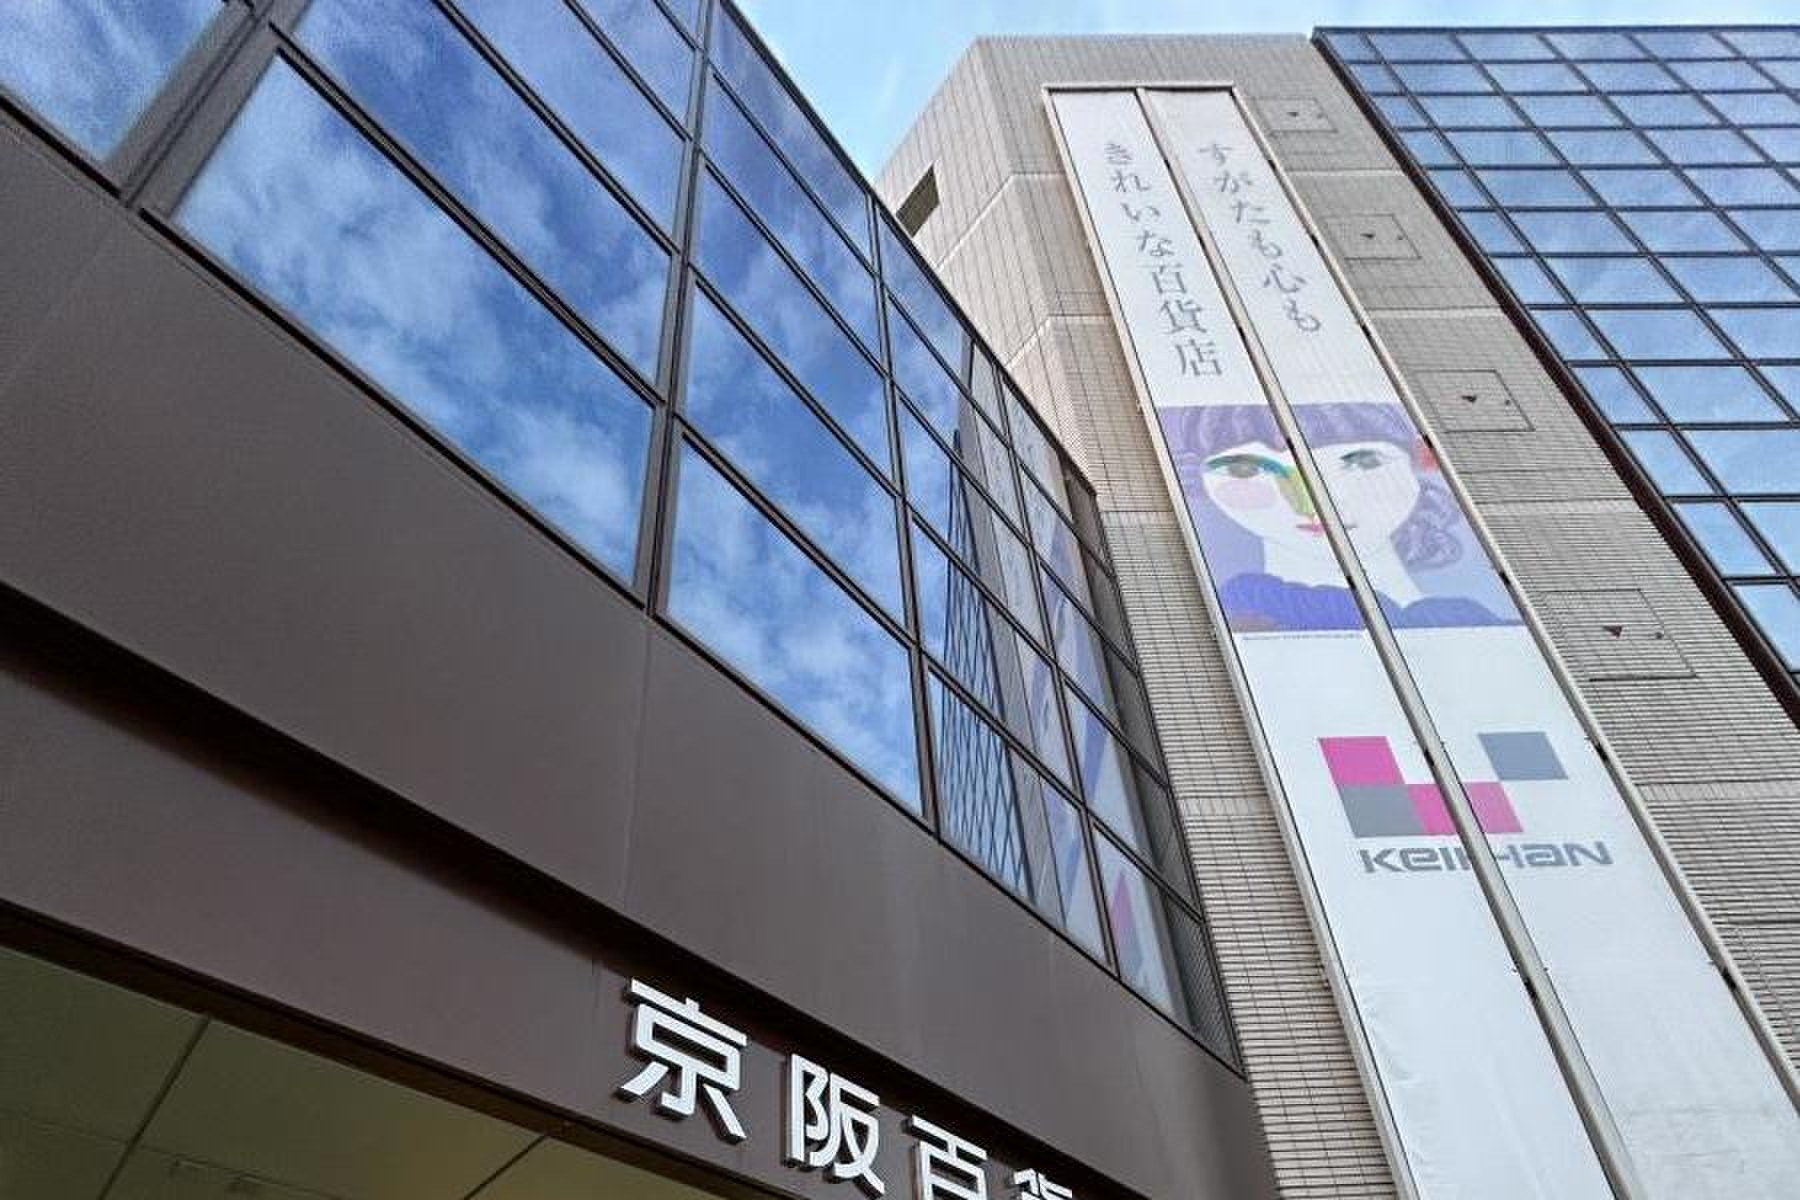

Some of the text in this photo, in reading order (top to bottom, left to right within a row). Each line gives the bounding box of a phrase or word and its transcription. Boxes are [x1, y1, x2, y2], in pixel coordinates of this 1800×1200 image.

[1103, 142, 1223, 377] きれいな百貨店
[1199, 142, 1321, 333] すがたも心も
